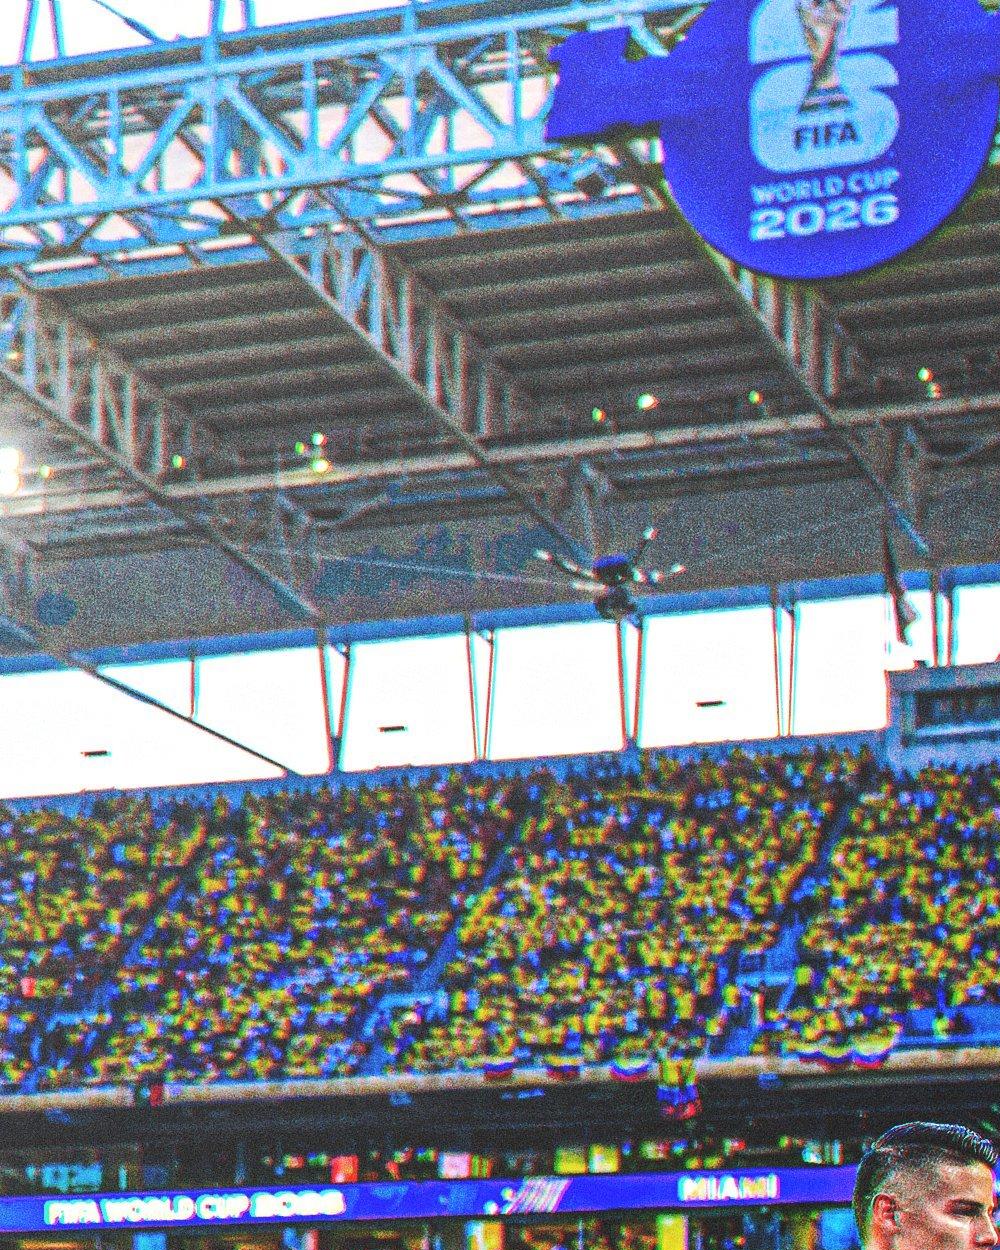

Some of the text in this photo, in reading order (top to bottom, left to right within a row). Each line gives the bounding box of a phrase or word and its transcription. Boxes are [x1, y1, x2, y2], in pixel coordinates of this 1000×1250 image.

[795, 121, 860, 151] FIFA
[752, 167, 900, 204] WORLD CUP
[751, 193, 900, 241] 2026
[679, 1174, 781, 1201] MIAMI
[44, 1200, 102, 1225] FIFA
[101, 1196, 195, 1222] WORLD
[196, 1194, 251, 1218] CUP
